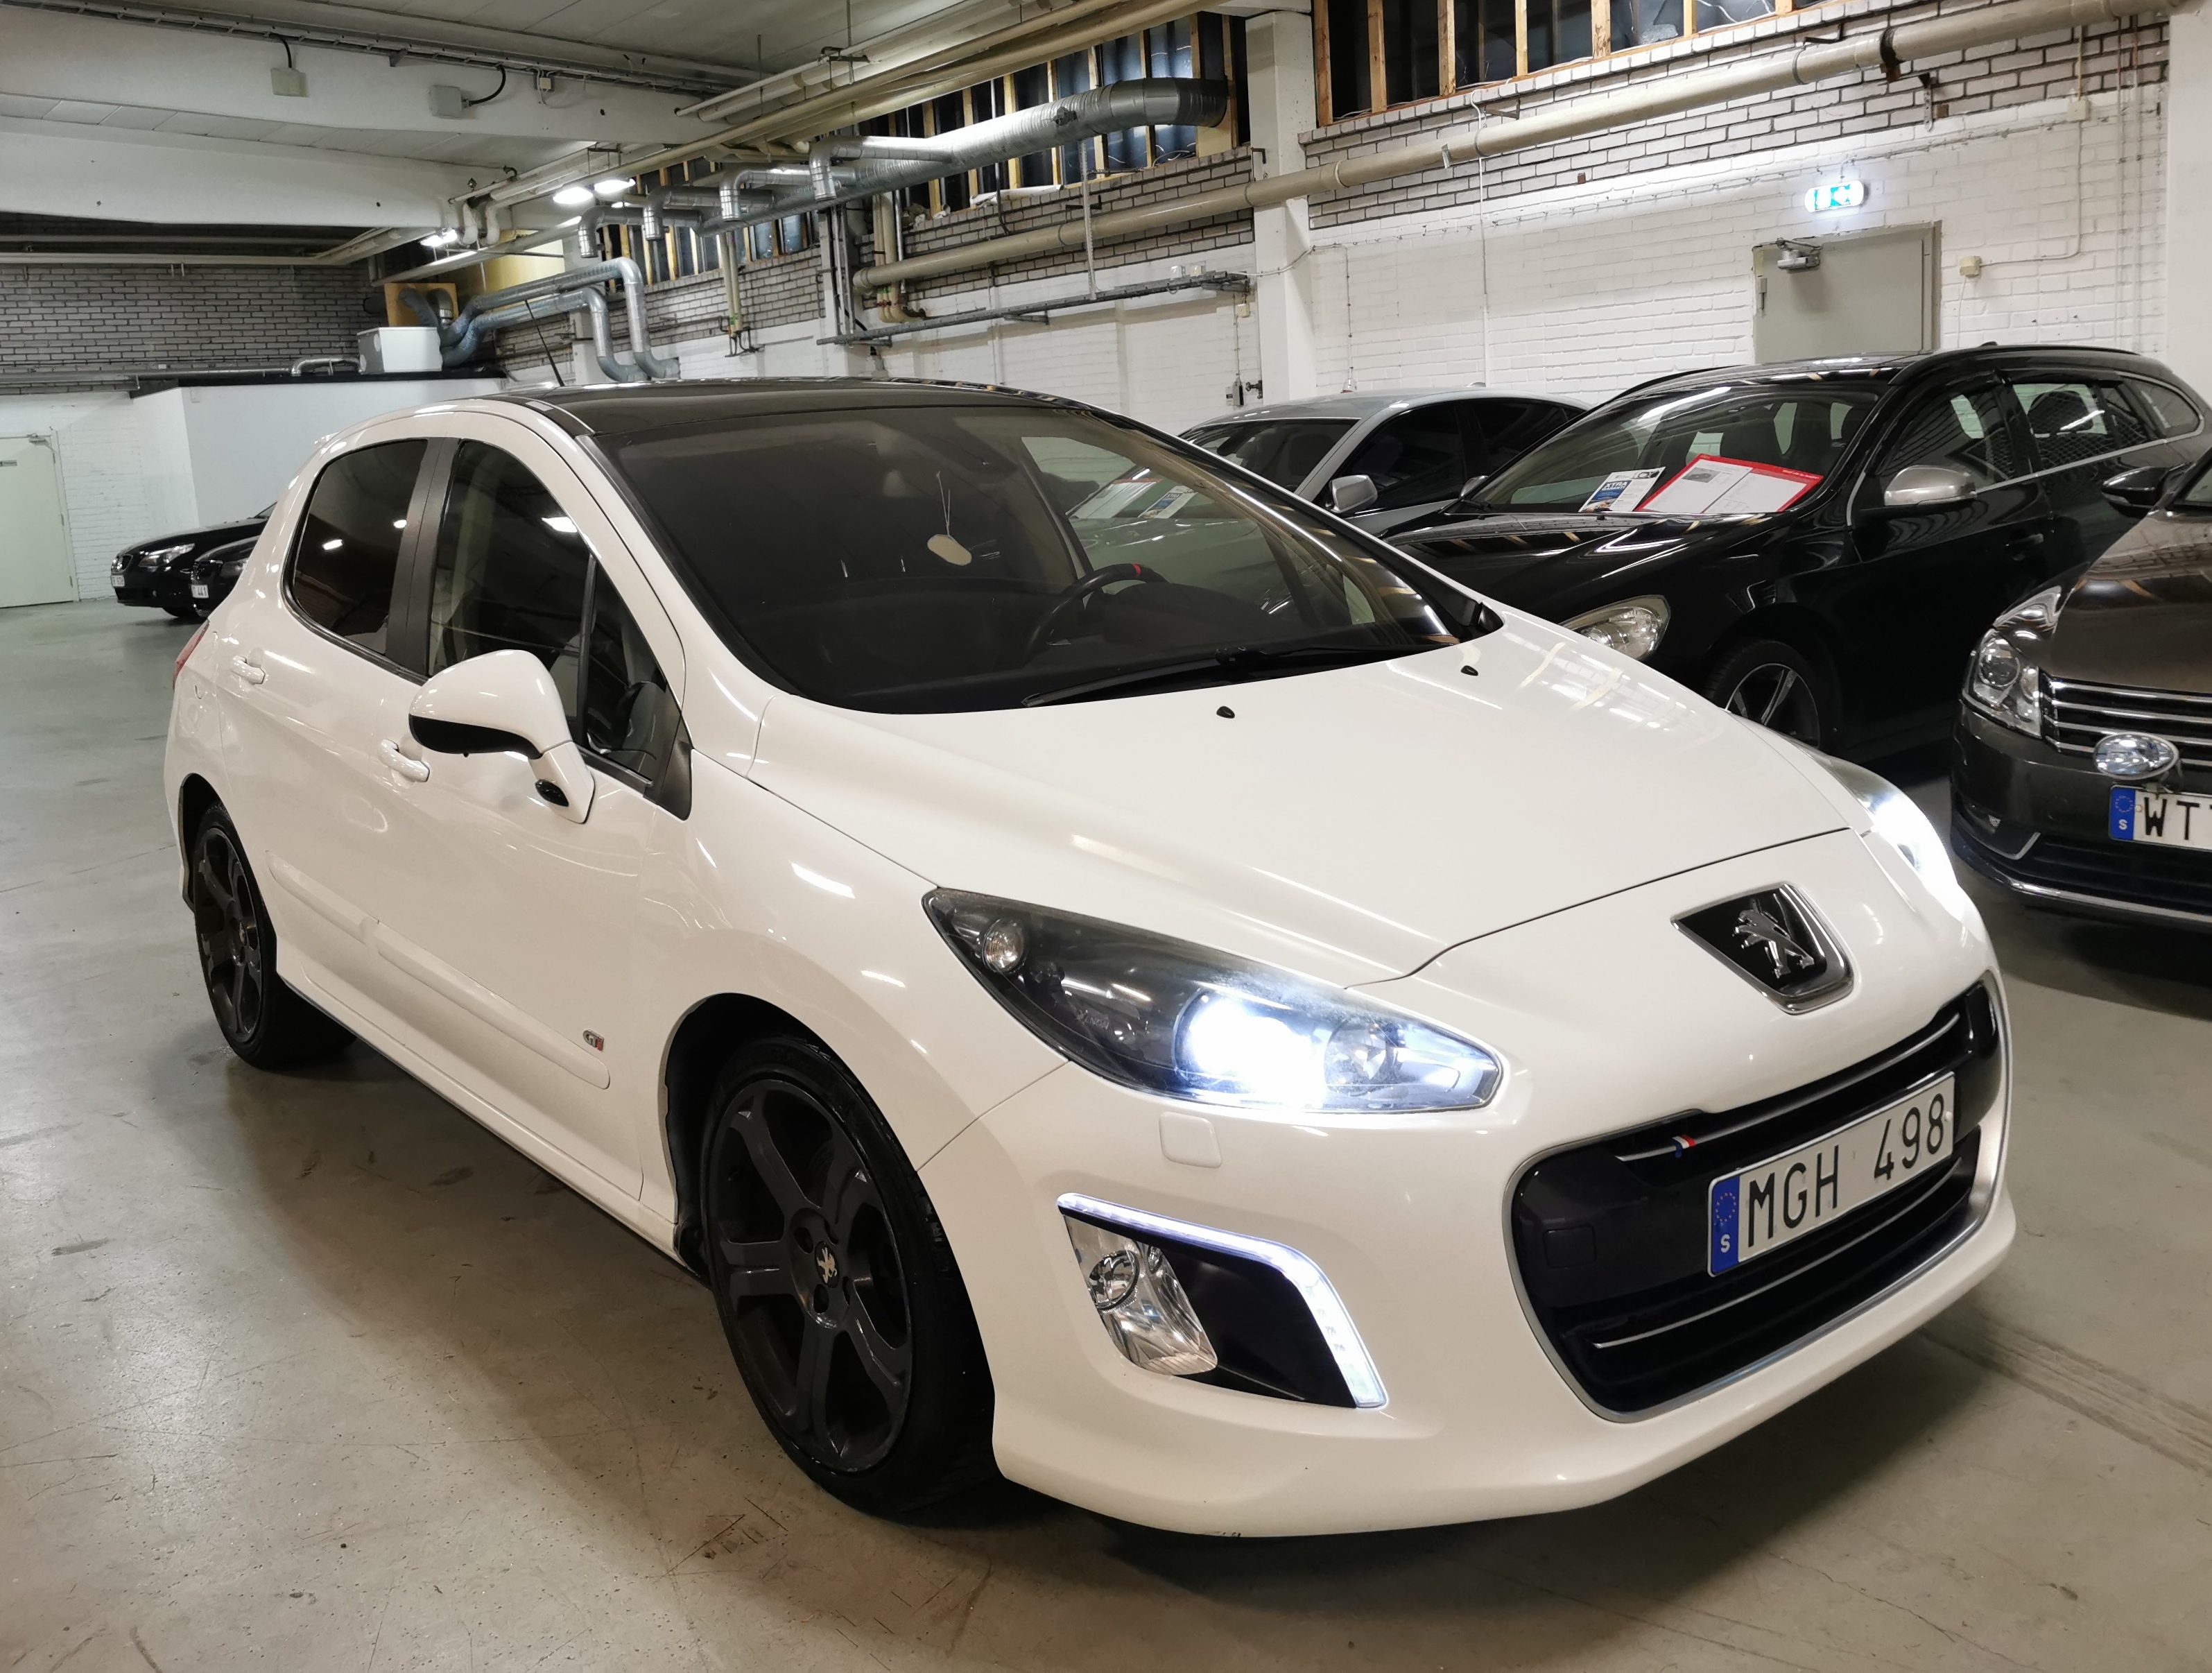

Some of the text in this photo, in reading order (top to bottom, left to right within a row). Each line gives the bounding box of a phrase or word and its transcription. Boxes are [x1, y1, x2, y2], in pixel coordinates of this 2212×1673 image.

[2118, 819, 2128, 830] S
[2144, 797, 2212, 841] WT
[1747, 1093, 1945, 1248] MGH 498
[1720, 1234, 1731, 1253] S
